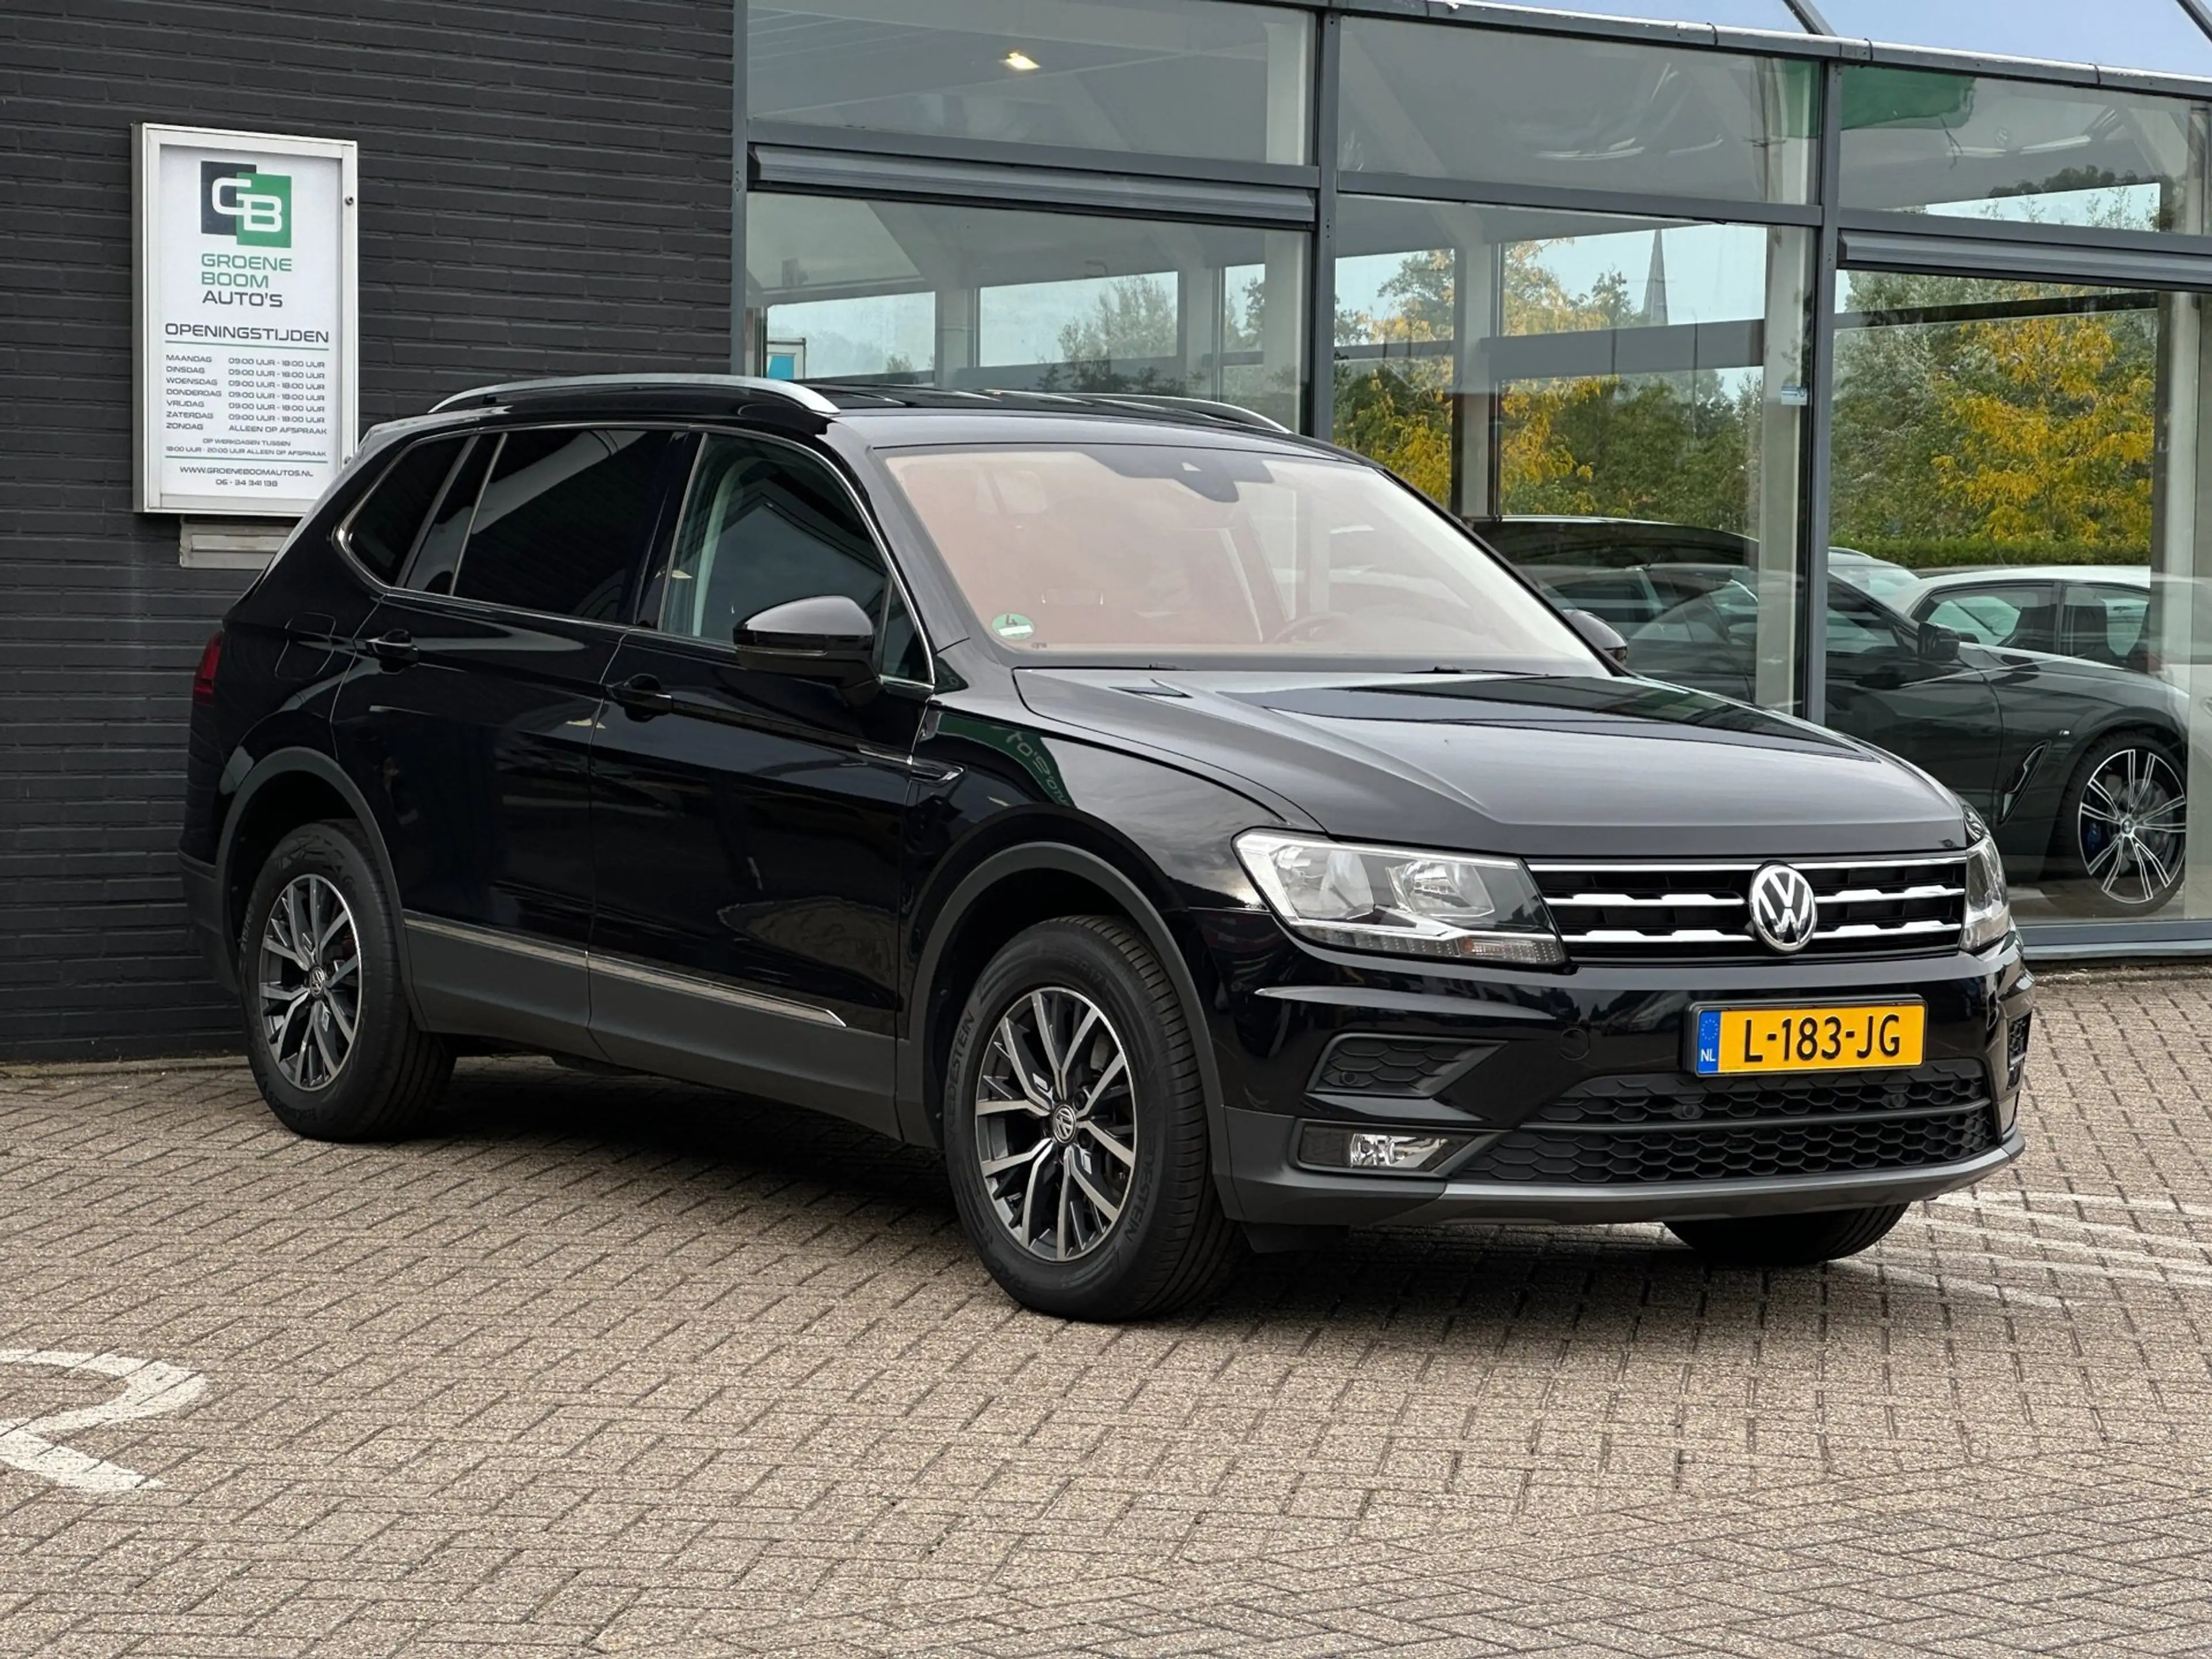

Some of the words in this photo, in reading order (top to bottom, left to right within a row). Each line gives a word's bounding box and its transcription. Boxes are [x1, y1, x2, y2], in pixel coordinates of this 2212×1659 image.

[202, 253, 292, 271] GROENE
[202, 271, 268, 289] BOOM
[202, 290, 282, 308] AUTO'S
[165, 323, 328, 343] OPENINGSTIJDEN
[1744, 1014, 1900, 1063] L-183-JG
[1700, 1048, 1716, 1062] NL
